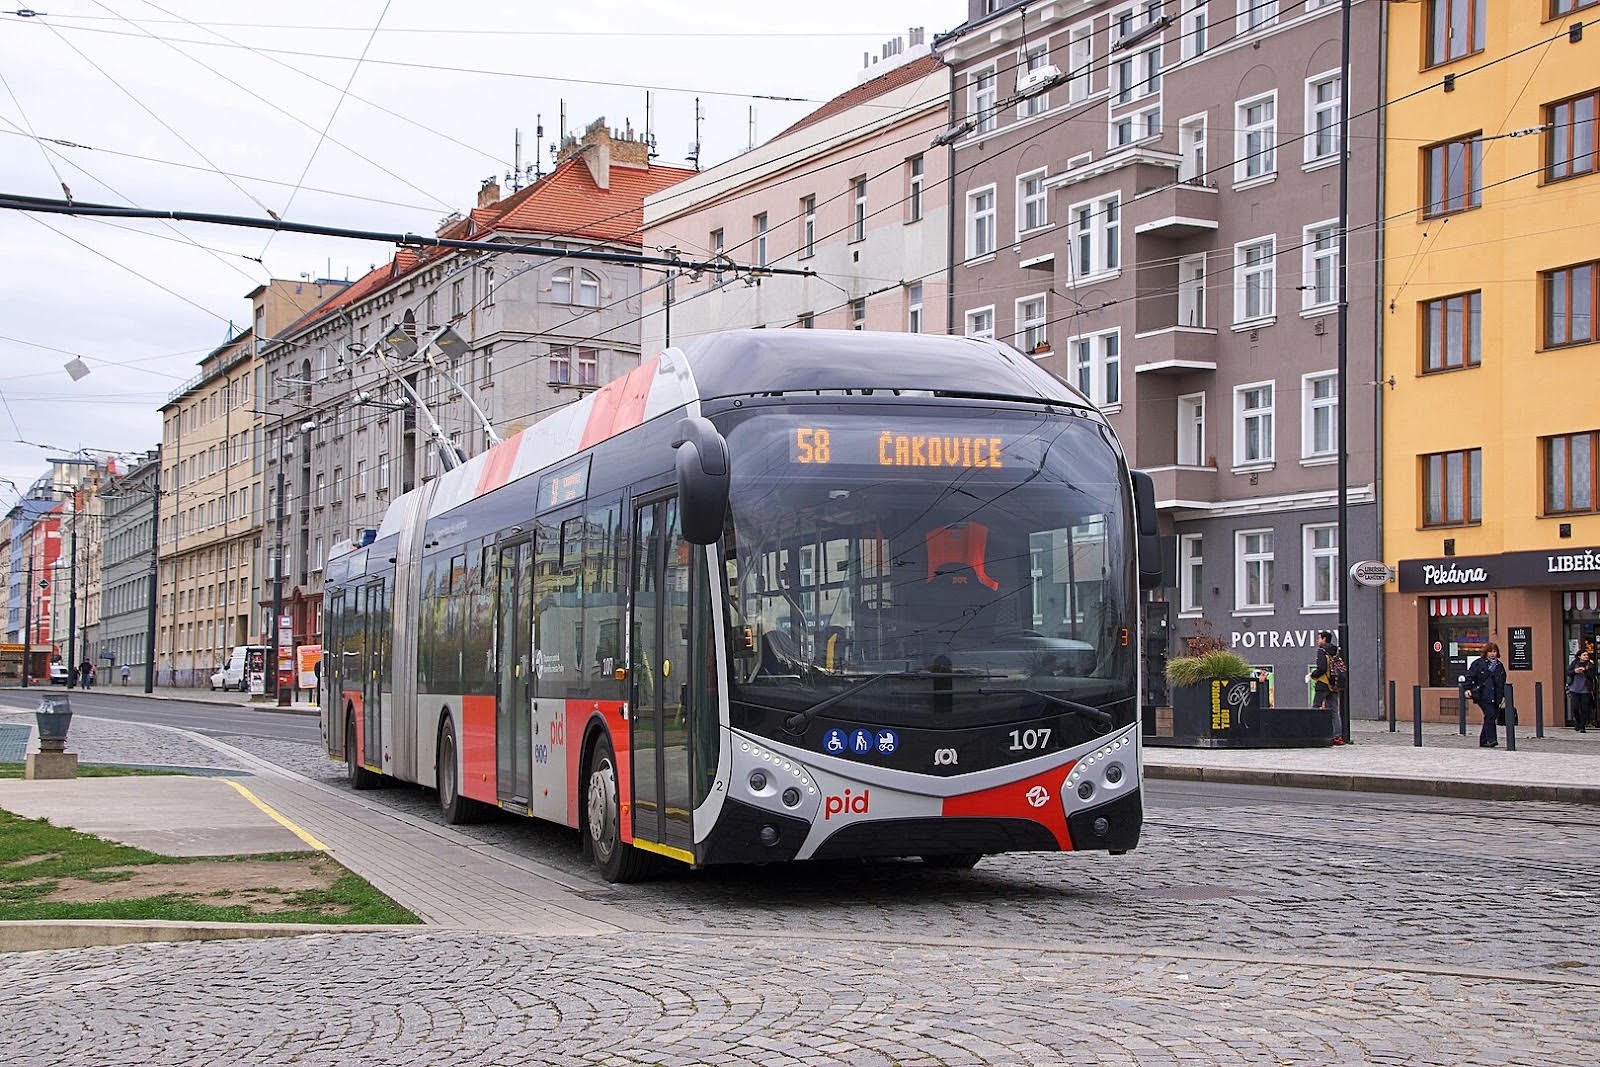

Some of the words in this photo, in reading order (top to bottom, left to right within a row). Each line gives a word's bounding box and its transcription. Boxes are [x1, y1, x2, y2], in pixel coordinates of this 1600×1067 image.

[796, 428, 830, 464] 58
[879, 430, 1003, 468] ČAKOVICE
[1423, 563, 1487, 584] Pekárna
[1231, 629, 1340, 648] POTRAVI
[602, 657, 614, 676] 107
[1211, 680, 1220, 730] PALMOVKA
[550, 711, 564, 752] pid
[1008, 728, 1052, 751] 107
[715, 780, 724, 792] 2
[825, 788, 869, 820] pid
